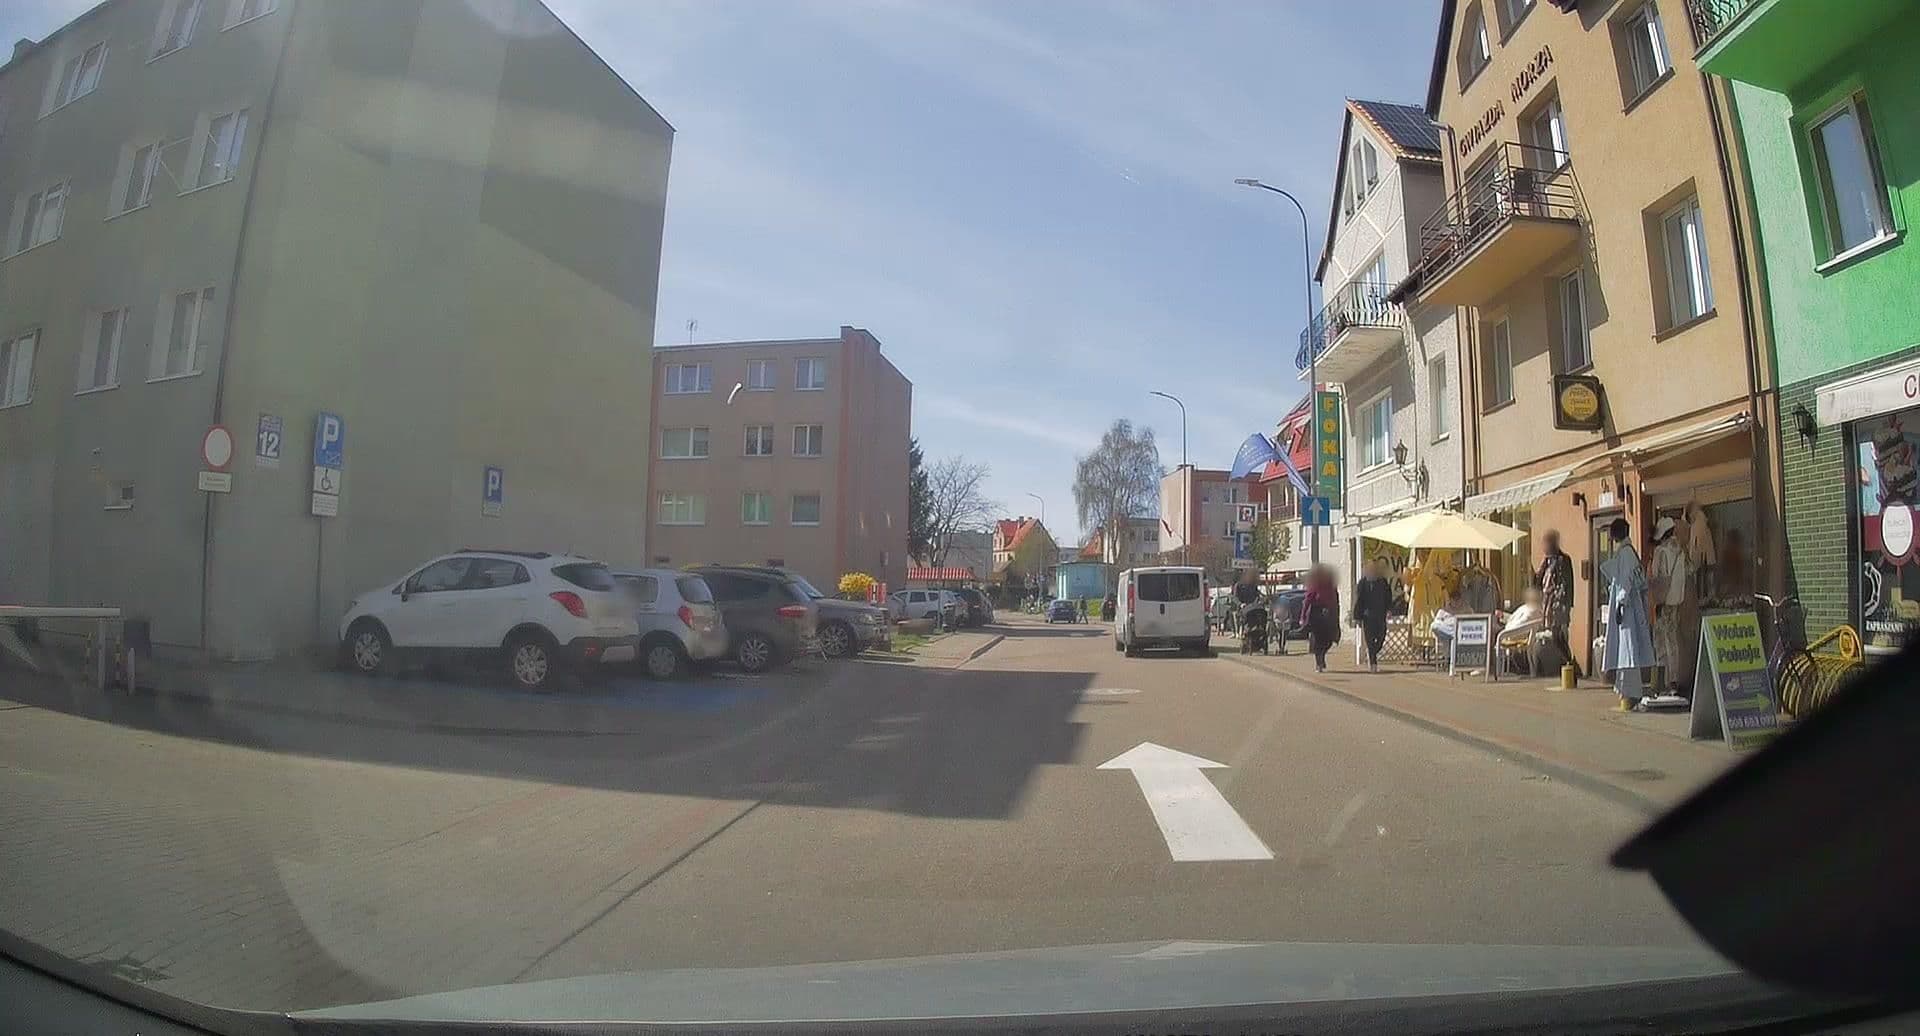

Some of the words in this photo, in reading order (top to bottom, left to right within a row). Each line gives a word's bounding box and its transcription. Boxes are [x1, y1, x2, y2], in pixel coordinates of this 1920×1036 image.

[1460, 99, 1505, 157] GWIAZDA
[1511, 45, 1553, 104] MORZA
[259, 430, 279, 457] 12
[321, 415, 339, 450] P
[1322, 396, 1337, 476] FOKA
[487, 469, 500, 497] P
[1713, 622, 1756, 640] Wolne
[1717, 644, 1761, 664] Pokoje
